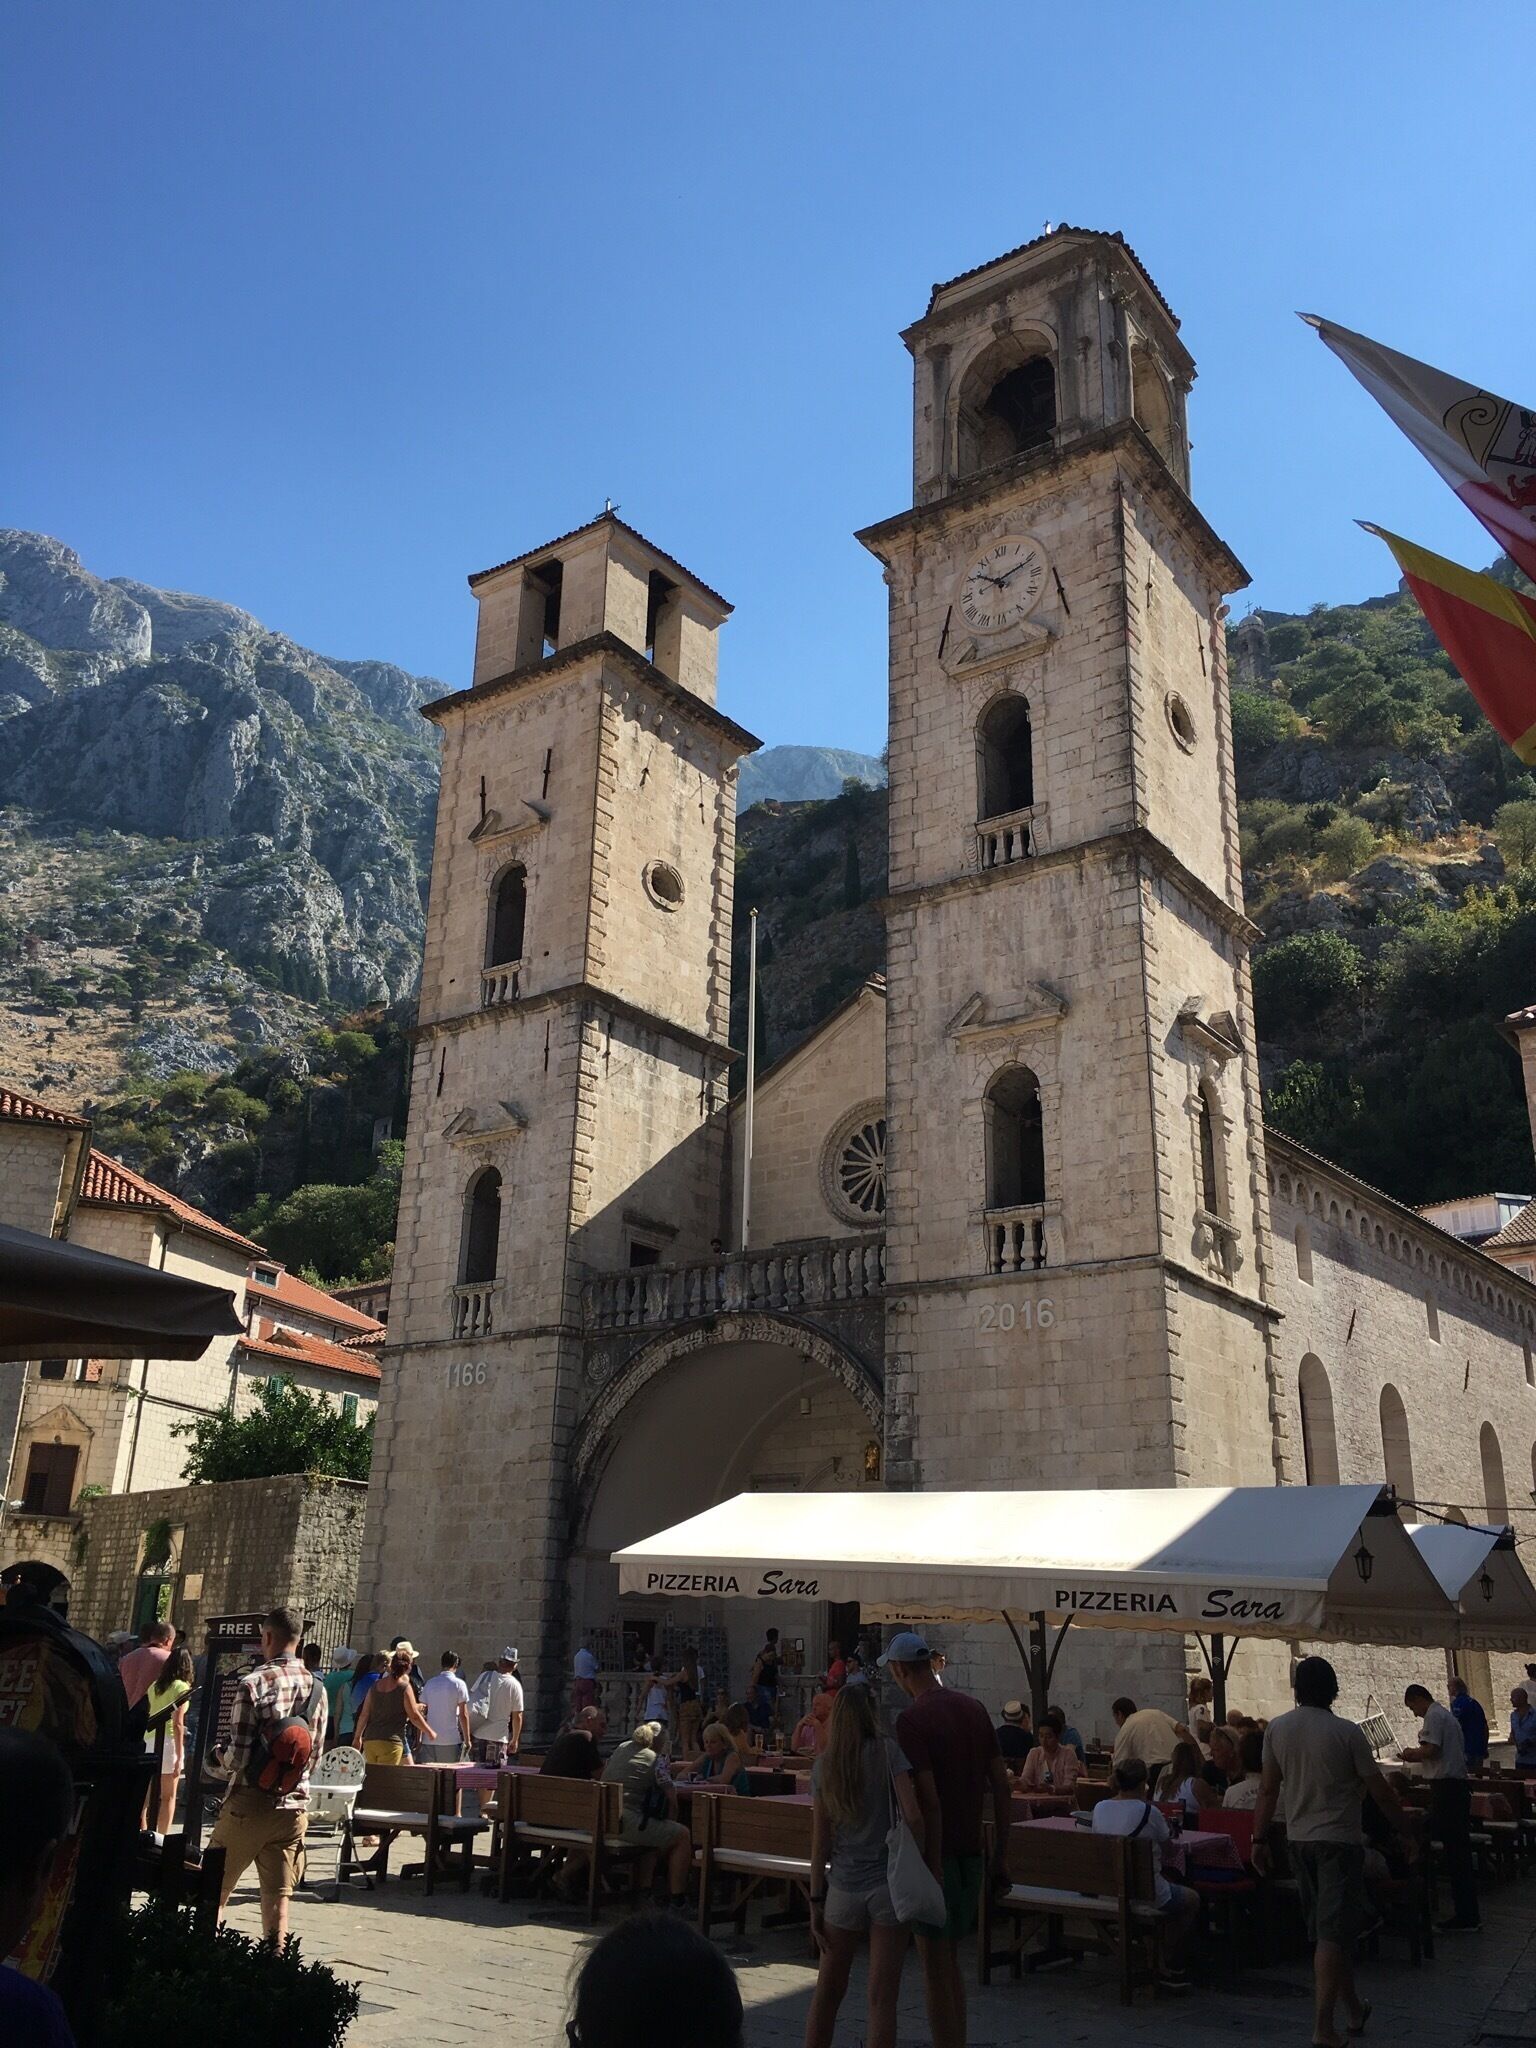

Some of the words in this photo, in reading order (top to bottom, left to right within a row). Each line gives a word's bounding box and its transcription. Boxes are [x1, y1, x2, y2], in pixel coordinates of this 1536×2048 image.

[994, 545, 1006, 559] XII
[978, 556, 990, 569] XI
[1030, 566, 1042, 578] III
[1026, 586, 1038, 596] IV
[962, 592, 973, 604] IX
[965, 605, 977, 621] VIII
[997, 614, 1007, 625] VI
[977, 614, 991, 627] VII
[979, 1298, 1055, 1334] 2016
[444, 1361, 487, 1389] 1166
[647, 1572, 740, 1593] PIZZERIA
[757, 1570, 821, 1596] Sara
[1055, 1589, 1178, 1614] PIZZERIA
[1201, 1589, 1285, 1620] Sara
[218, 1623, 253, 1635] FREE
